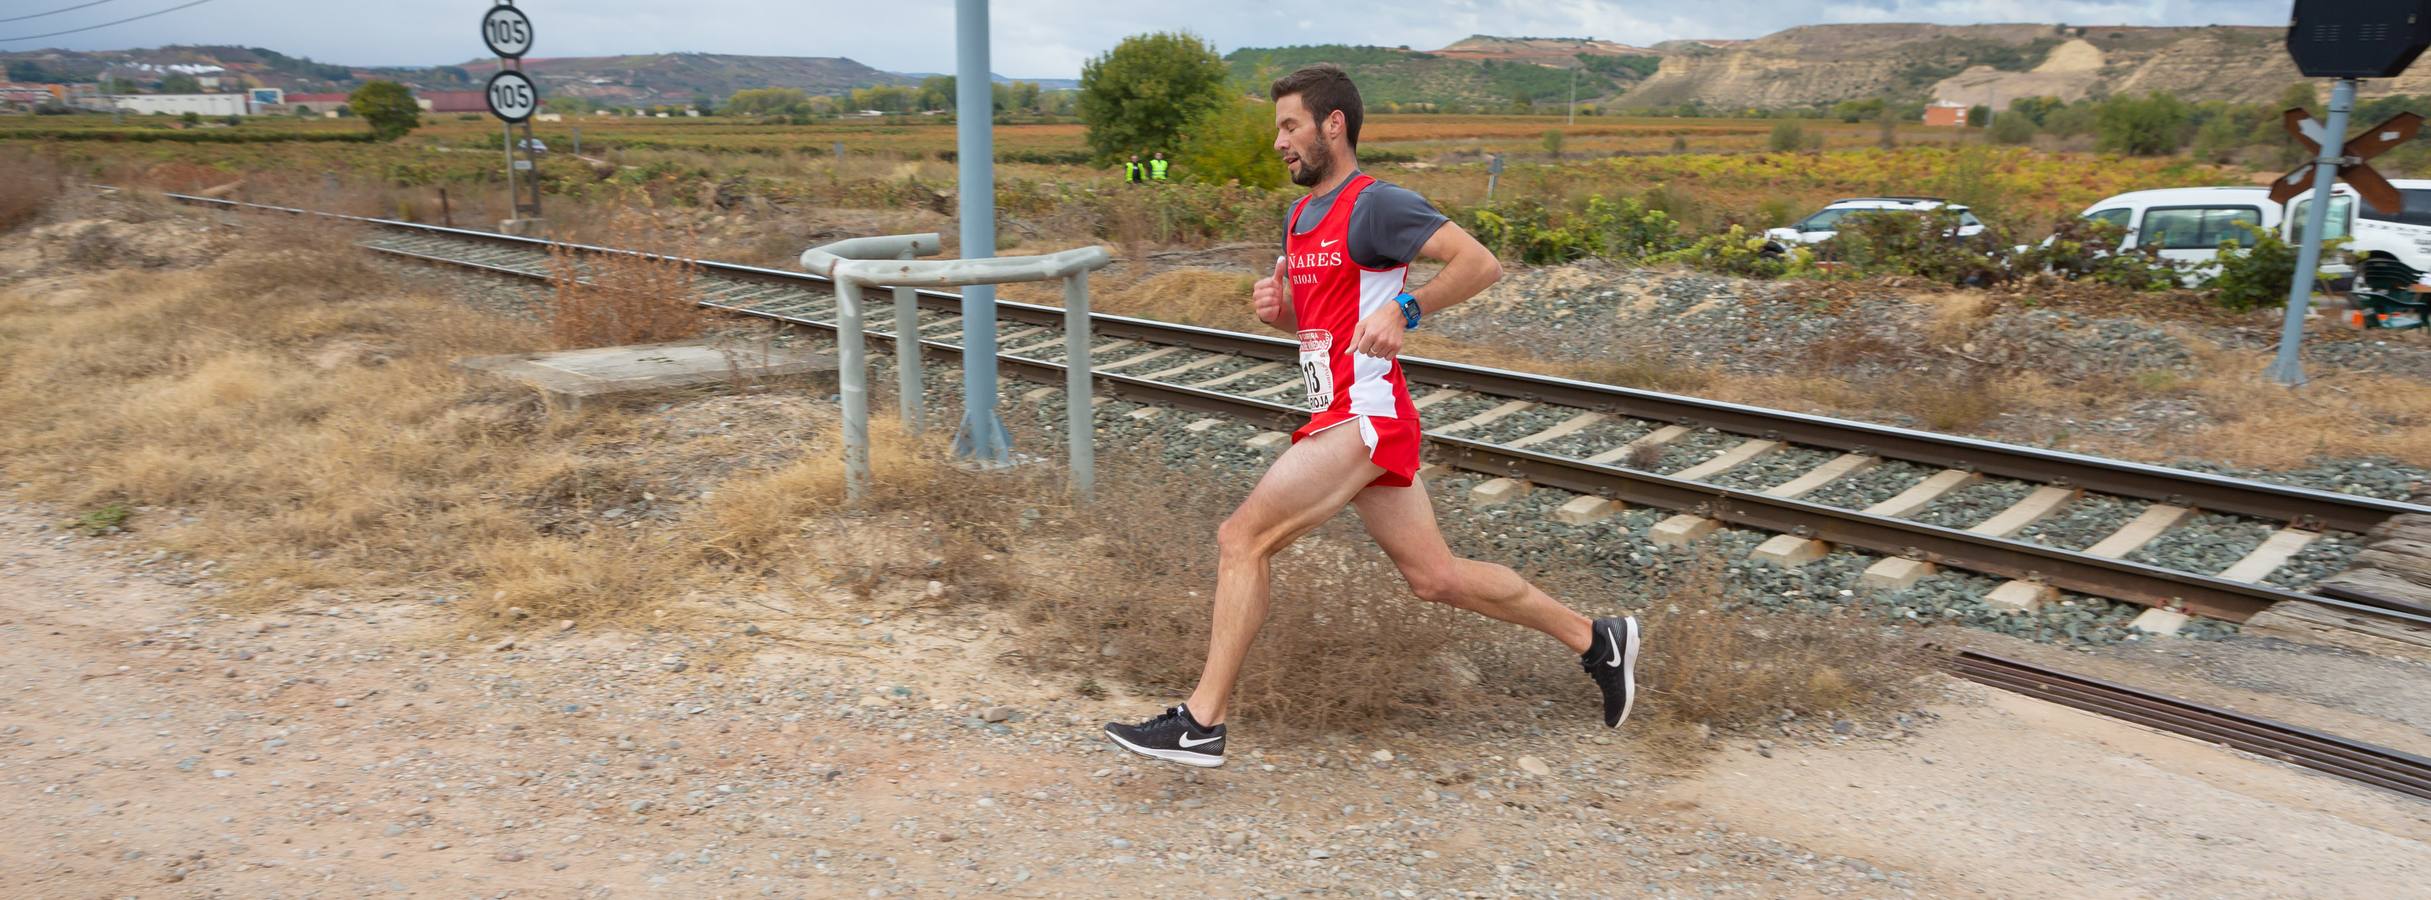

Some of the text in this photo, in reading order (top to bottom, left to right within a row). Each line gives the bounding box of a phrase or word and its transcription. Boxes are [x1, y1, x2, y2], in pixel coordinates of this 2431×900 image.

[487, 18, 525, 44] 105
[491, 84, 529, 109] 105
[1293, 273, 1318, 285] RIOJA
